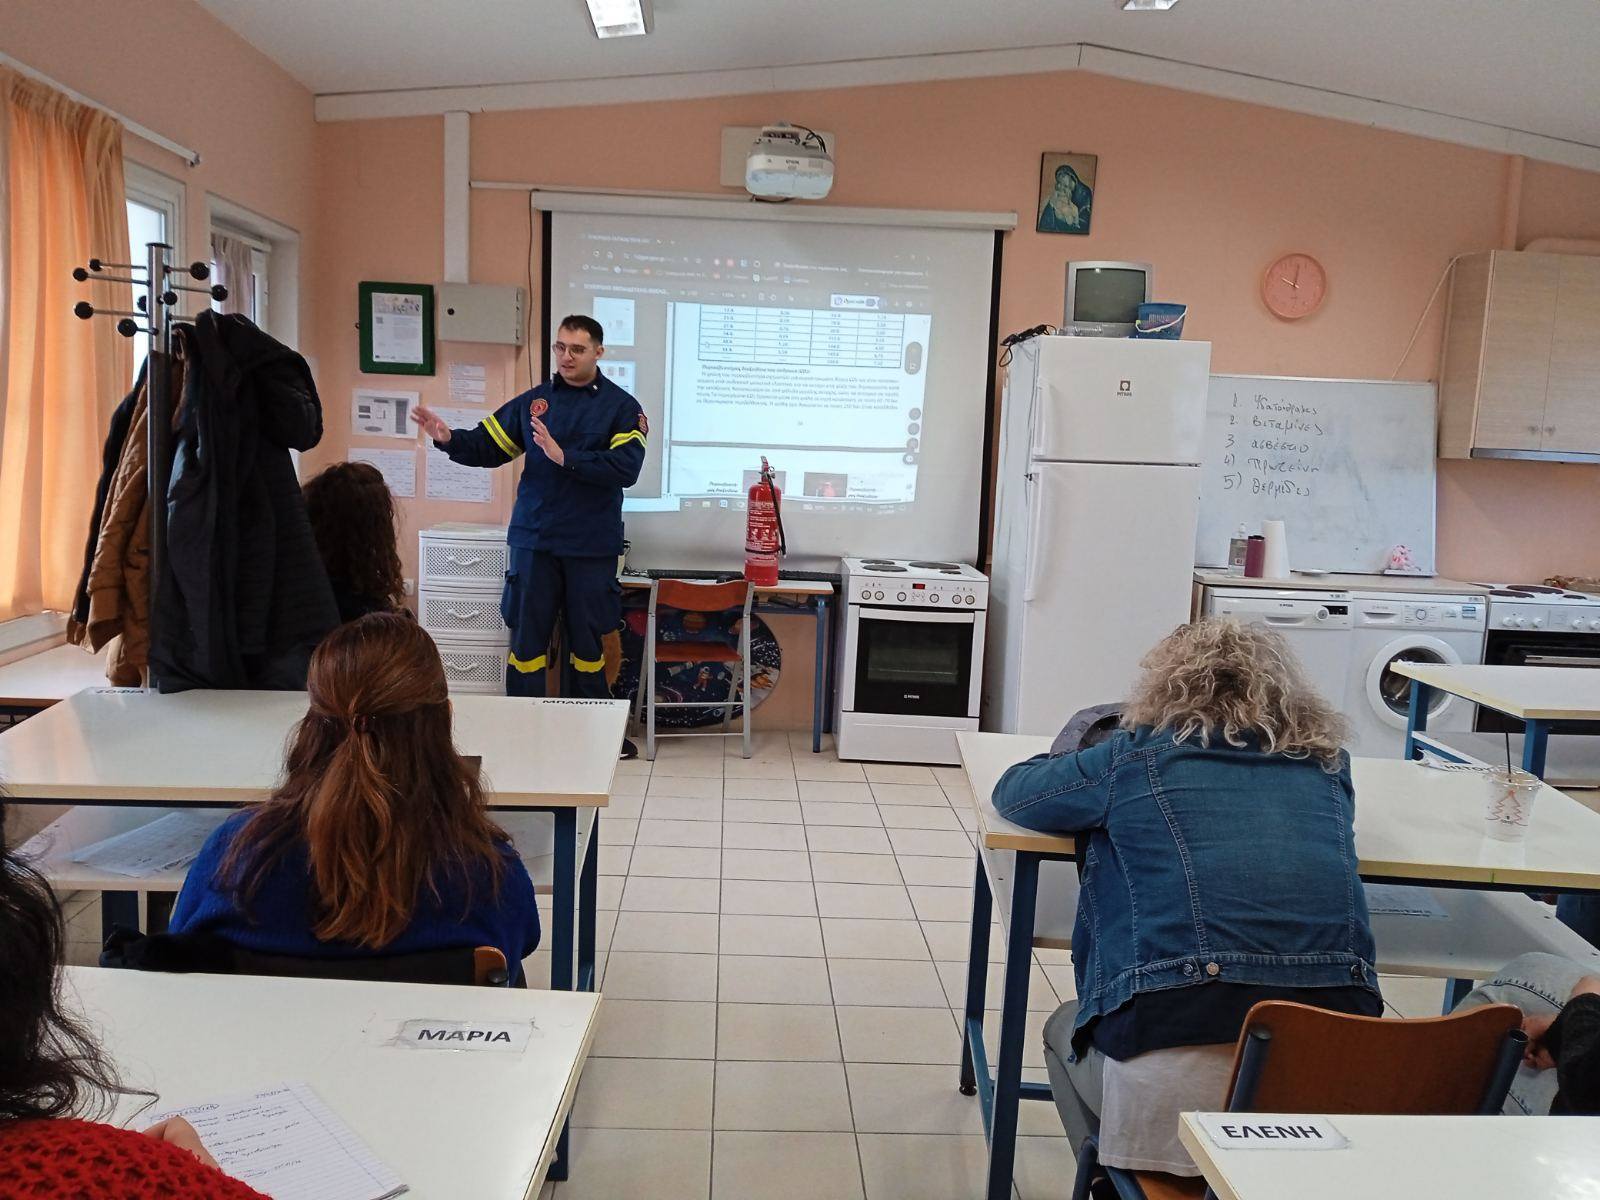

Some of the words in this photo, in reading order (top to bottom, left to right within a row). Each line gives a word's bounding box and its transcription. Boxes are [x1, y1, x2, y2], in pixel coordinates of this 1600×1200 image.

[1225, 434, 1235, 448] 3
[1223, 453, 1236, 465] 4)
[1223, 471, 1242, 490] 5)
[418, 1029, 511, 1042] ΜΑΡΙΑ
[1221, 1125, 1323, 1138] ΕΛΕΝΗ
